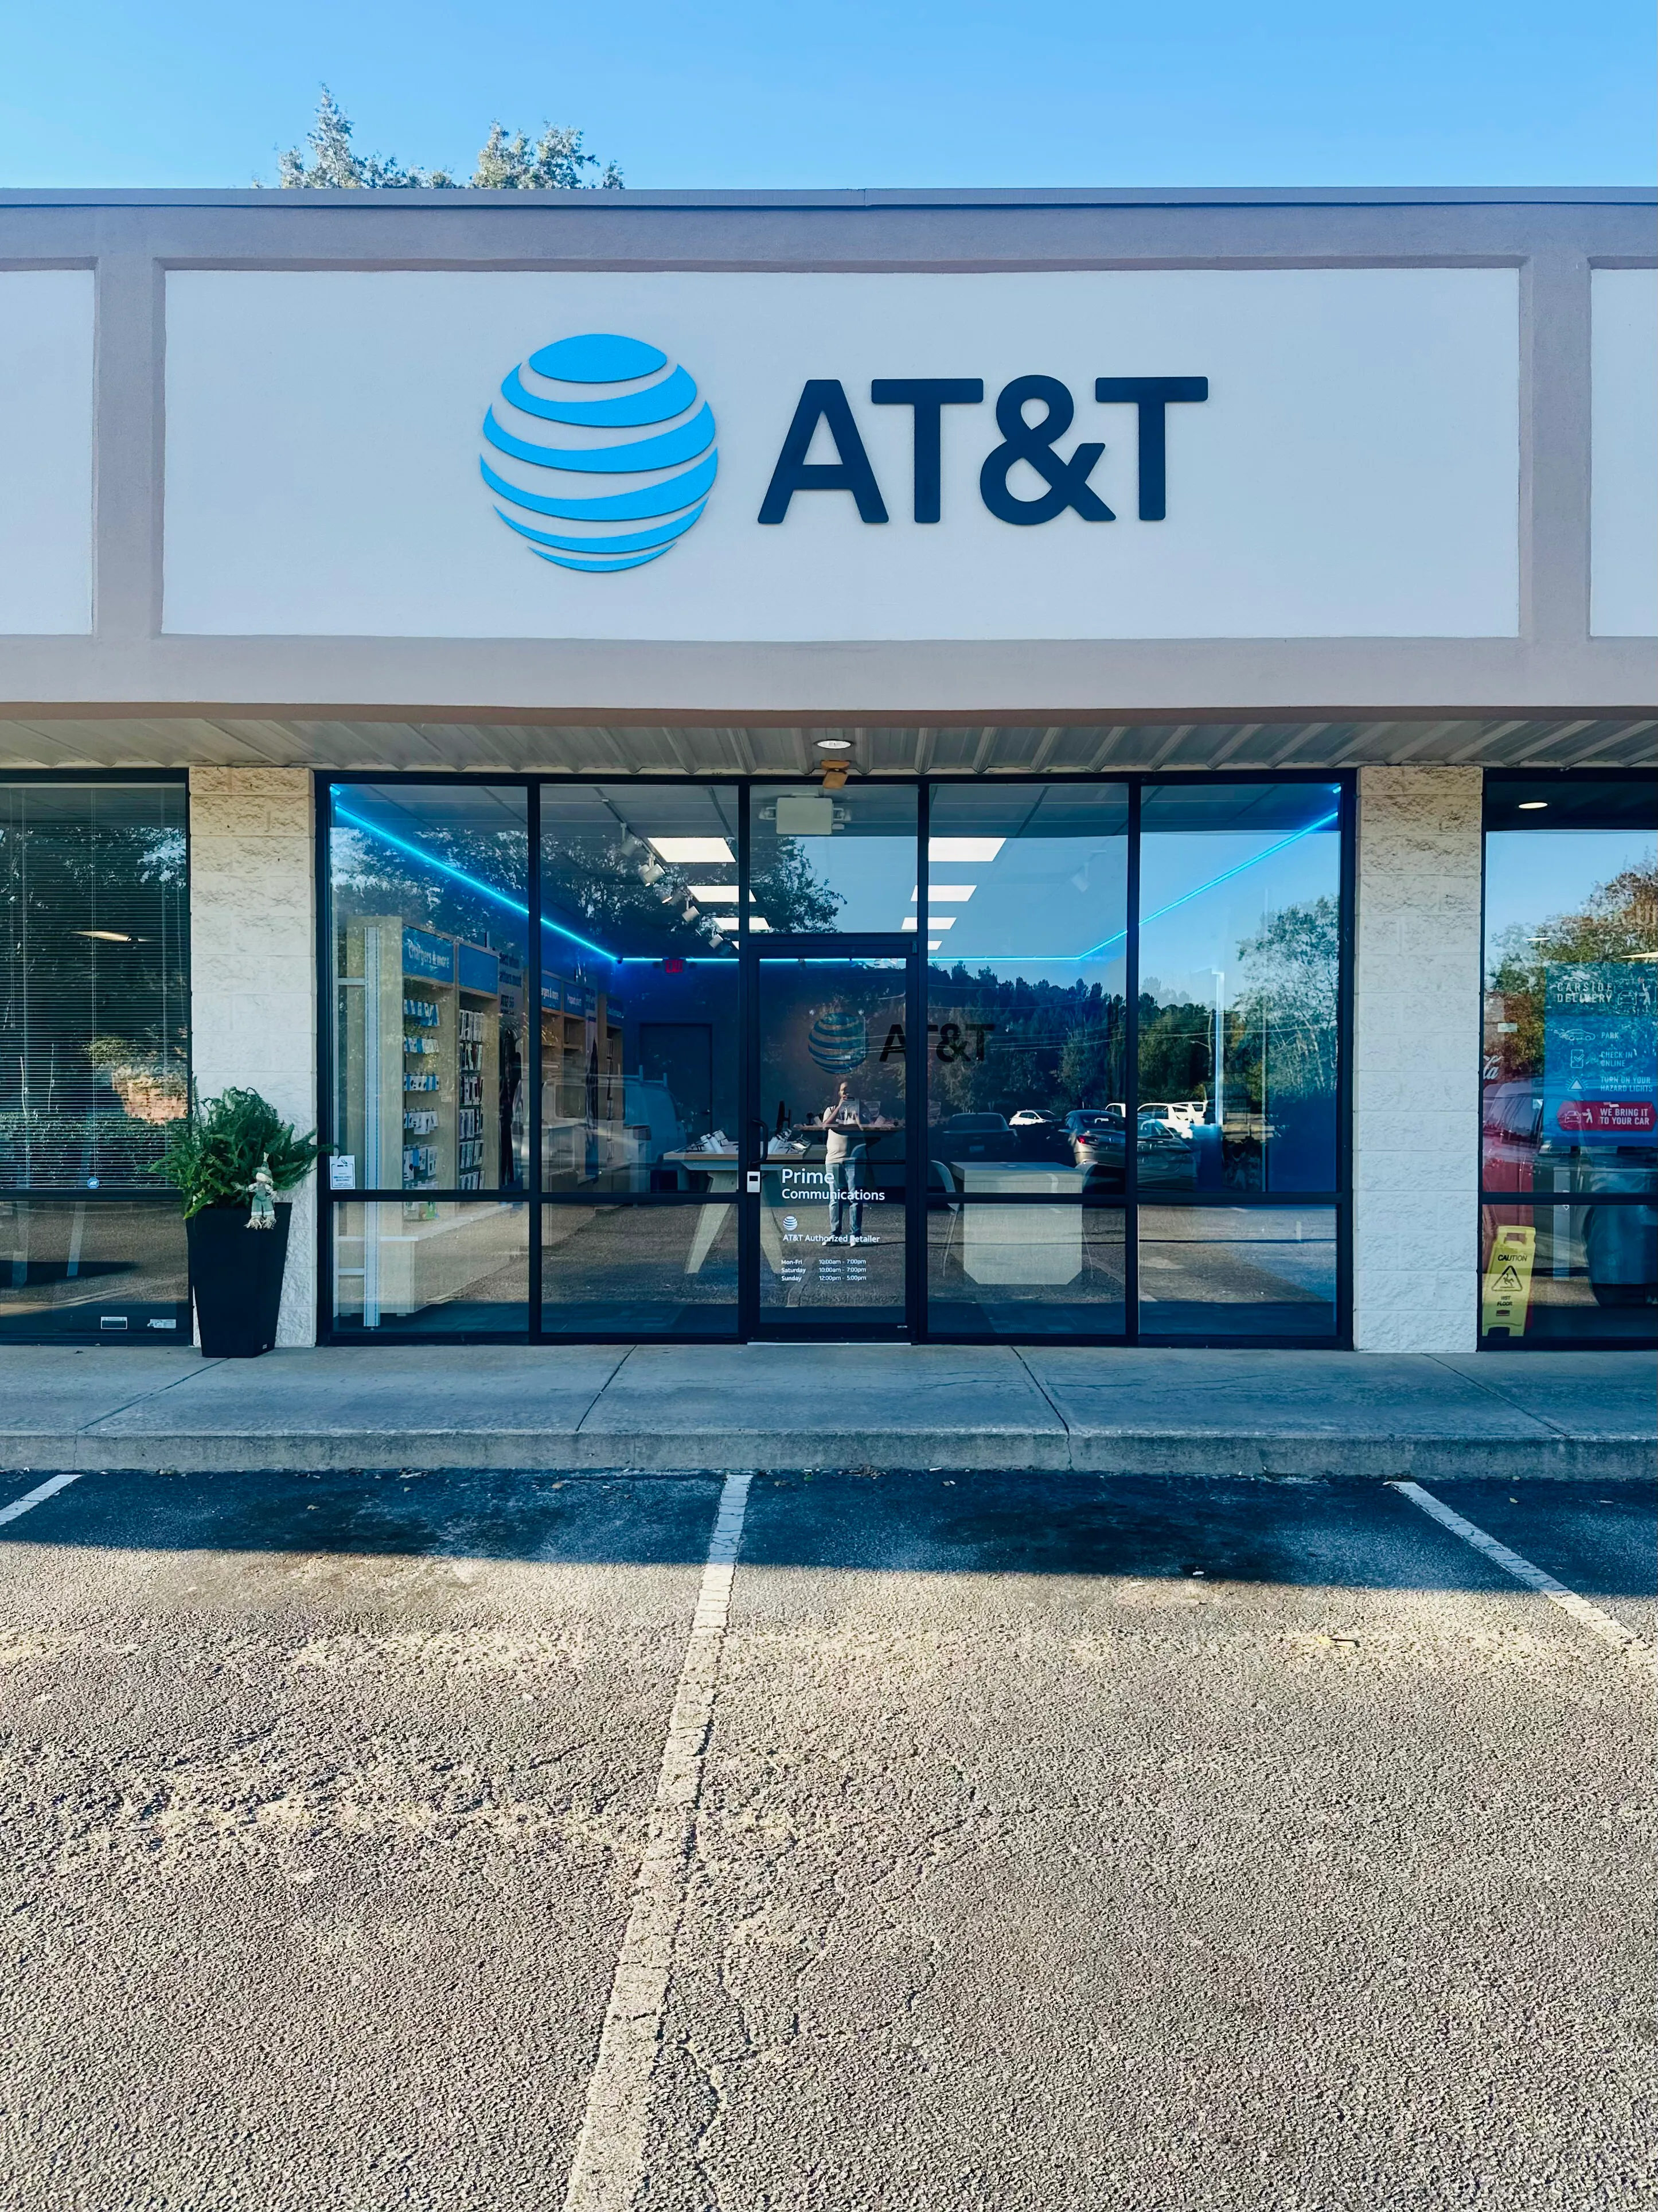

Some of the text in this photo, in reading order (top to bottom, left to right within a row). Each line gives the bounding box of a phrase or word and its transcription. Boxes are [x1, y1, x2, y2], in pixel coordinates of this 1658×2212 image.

[758, 375, 1208, 525] AT&T
[1557, 982, 1613, 992] CARSIDE
[1557, 993, 1612, 1003] DELIVERY
[1633, 1076, 1651, 1084] YOUR
[1615, 1108, 1639, 1116] BRING
[1641, 1109, 1648, 1117] IT
[1600, 1116, 1649, 1125] TO YOUR CAR
[782, 1168, 834, 1184] Prime
[782, 1189, 885, 1201] Communications
[805, 1234, 848, 1243] Authorized
[850, 1234, 880, 1243] Retailer
